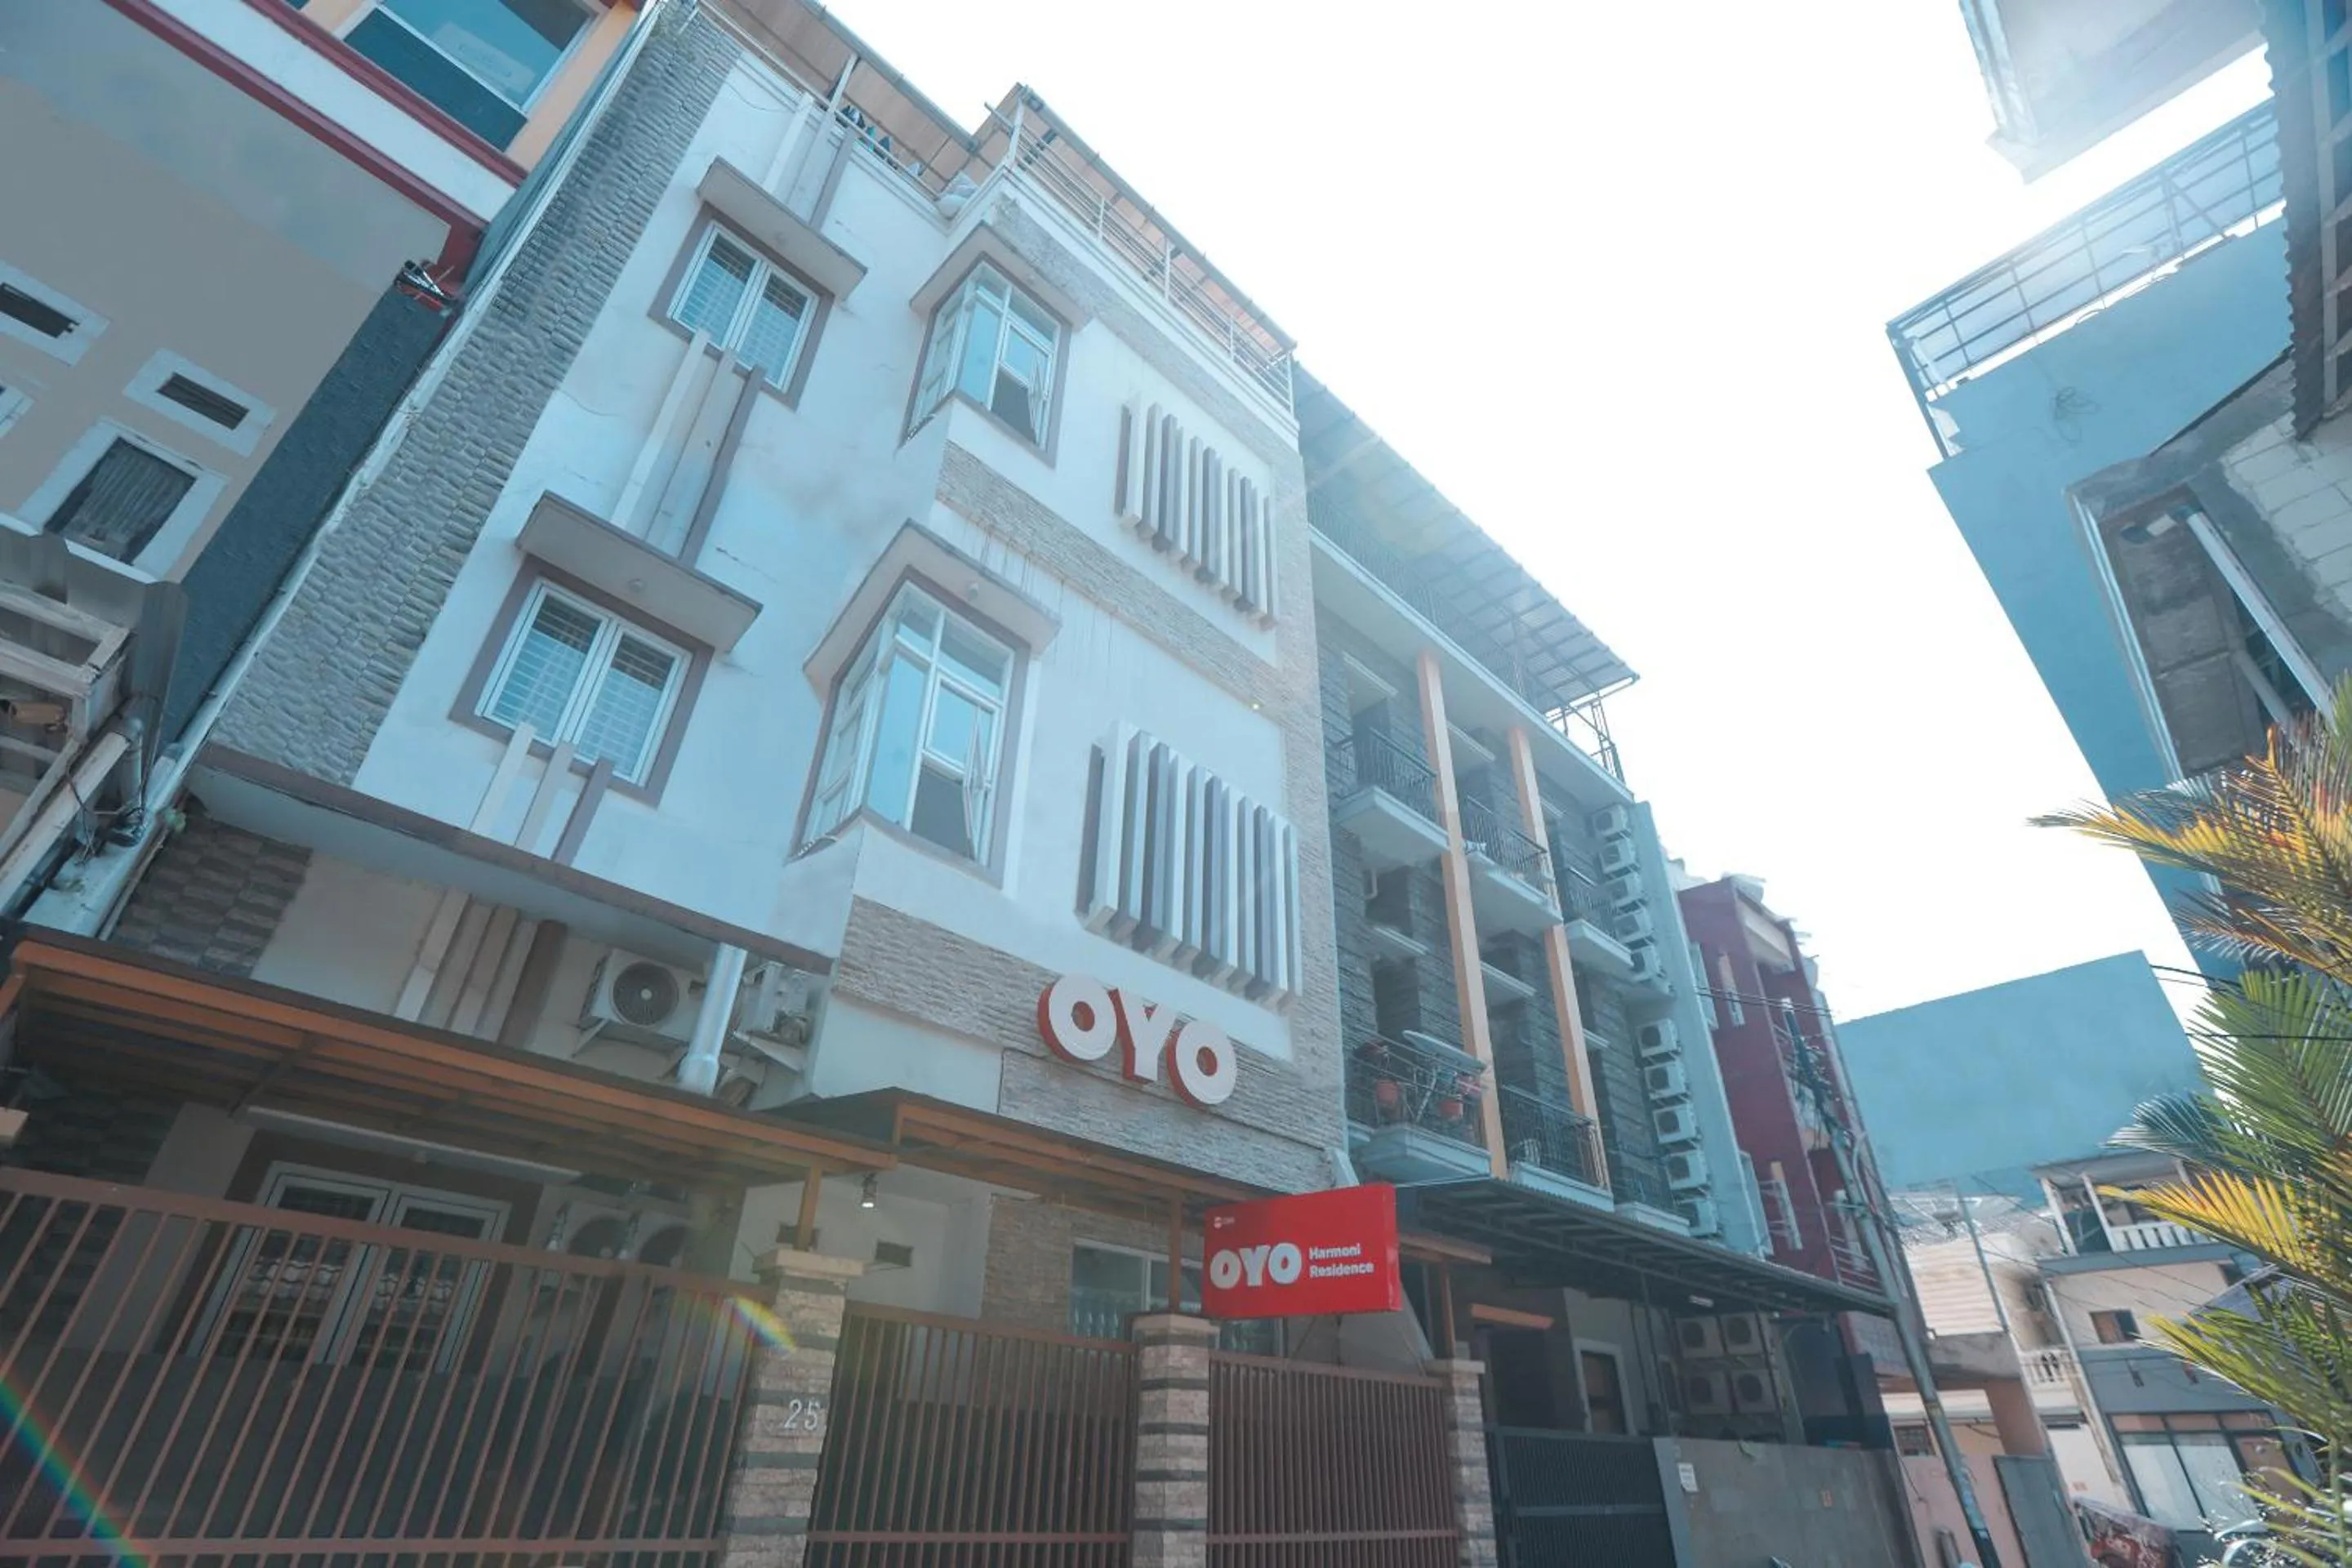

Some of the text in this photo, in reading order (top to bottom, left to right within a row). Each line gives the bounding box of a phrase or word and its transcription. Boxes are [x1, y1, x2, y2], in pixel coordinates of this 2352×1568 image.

[1038, 973, 1236, 1107] OYO
[1210, 1242, 1302, 1290] OYO
[1309, 1242, 1361, 1260] Harmoni
[1309, 1263, 1374, 1279] Residence
[784, 1399, 821, 1430] 25
